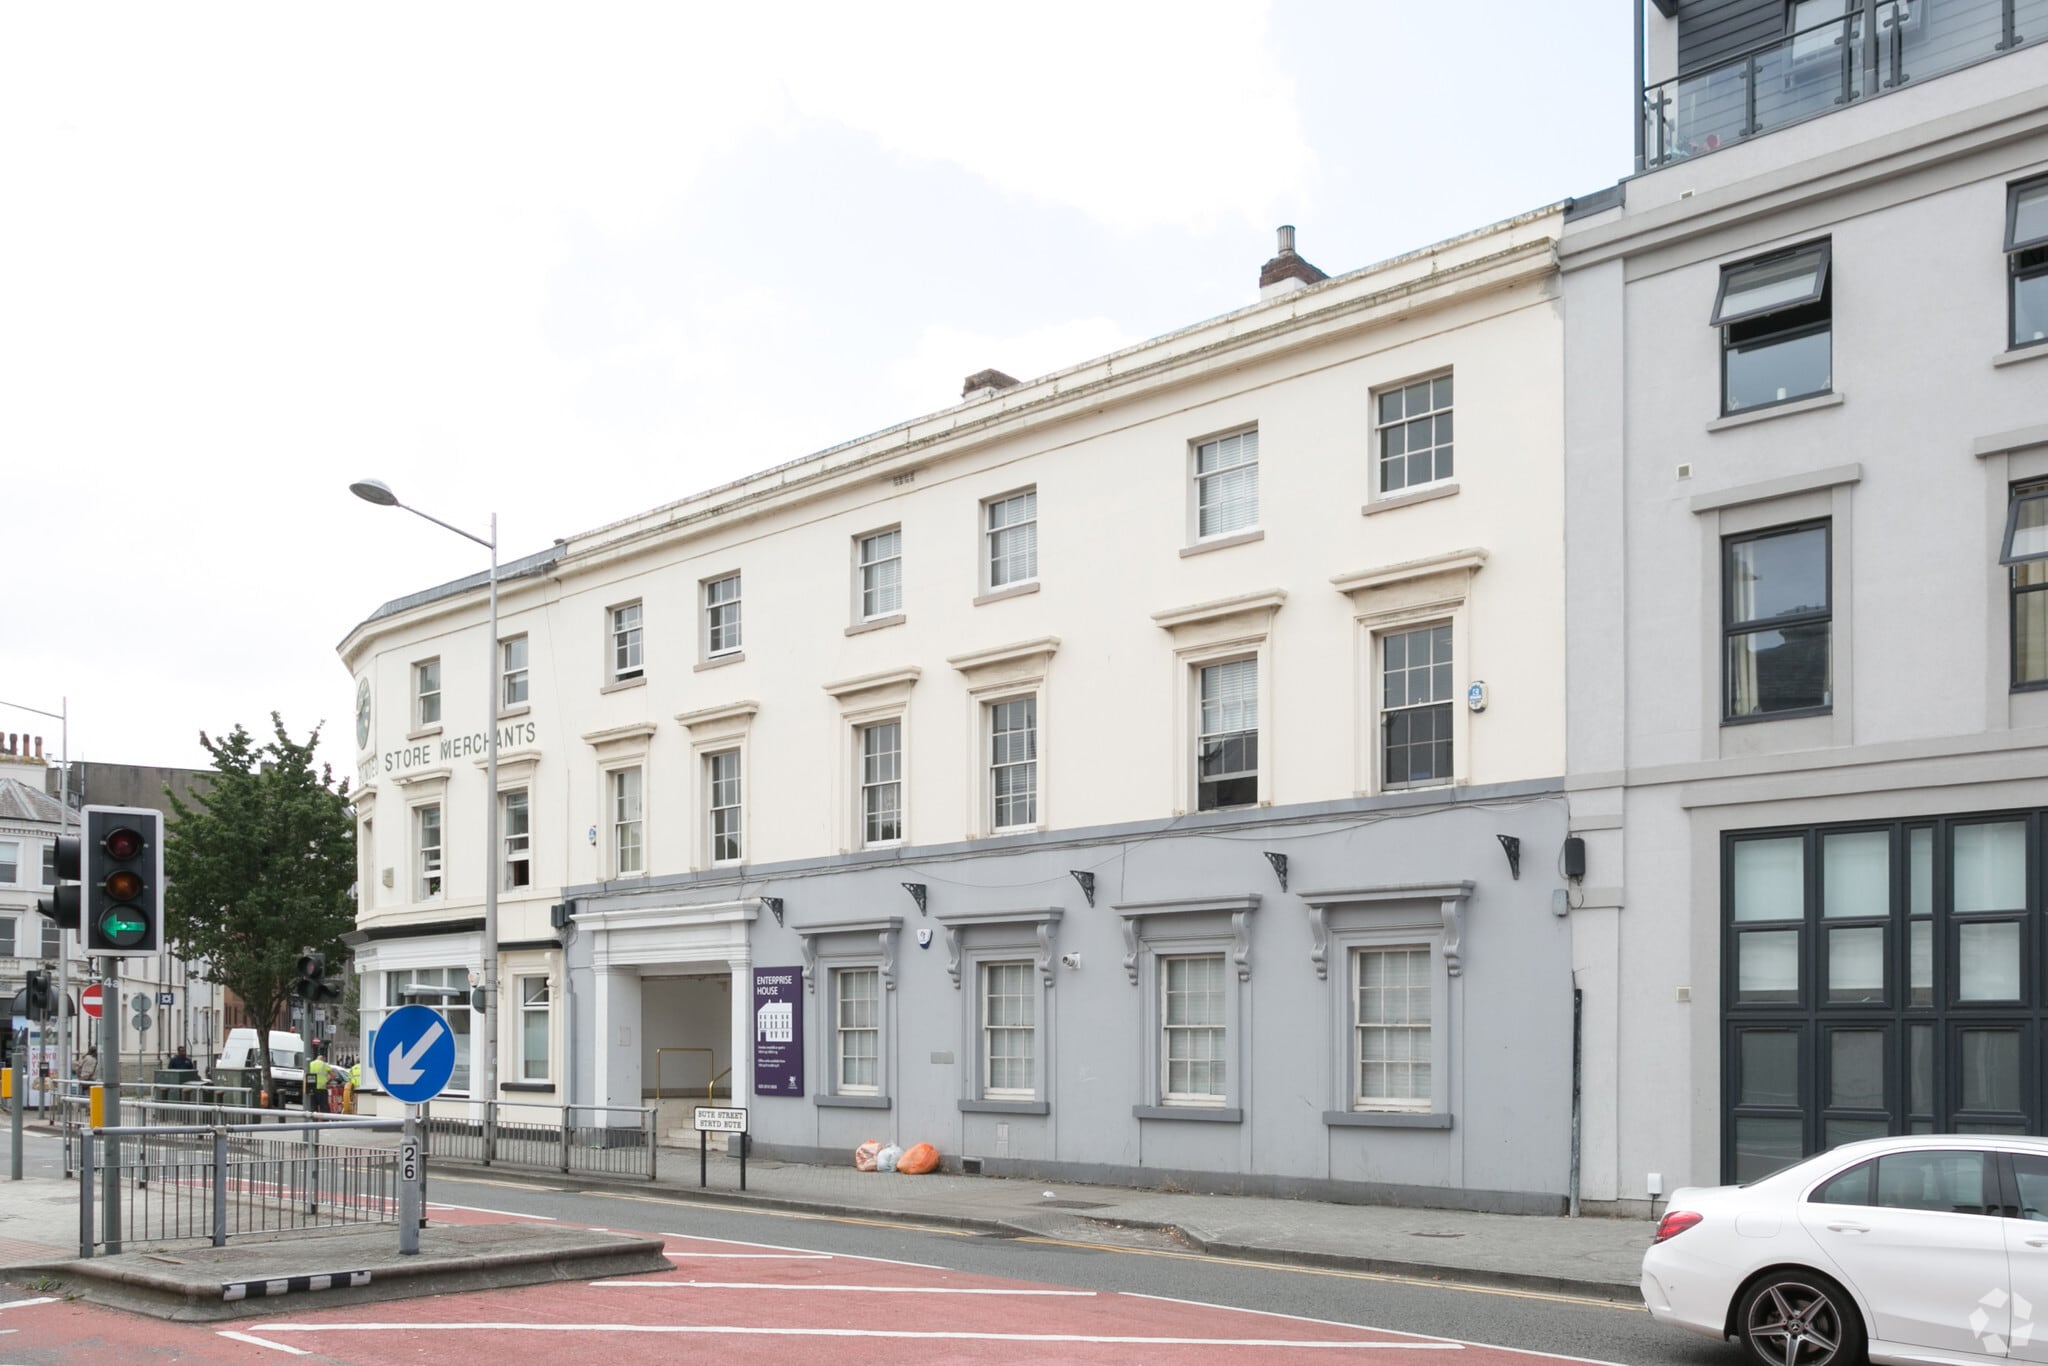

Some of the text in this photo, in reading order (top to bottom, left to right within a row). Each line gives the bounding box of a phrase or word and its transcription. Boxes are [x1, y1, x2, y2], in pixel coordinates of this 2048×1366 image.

[385, 745, 430, 772] STORE
[440, 721, 536, 760] MERCHANTS
[756, 975, 792, 985] ENTERPRISE
[756, 986, 778, 996] HOUSE
[698, 1110, 743, 1120] BUTE STREET
[700, 1120, 742, 1129] STRYD BUTE
